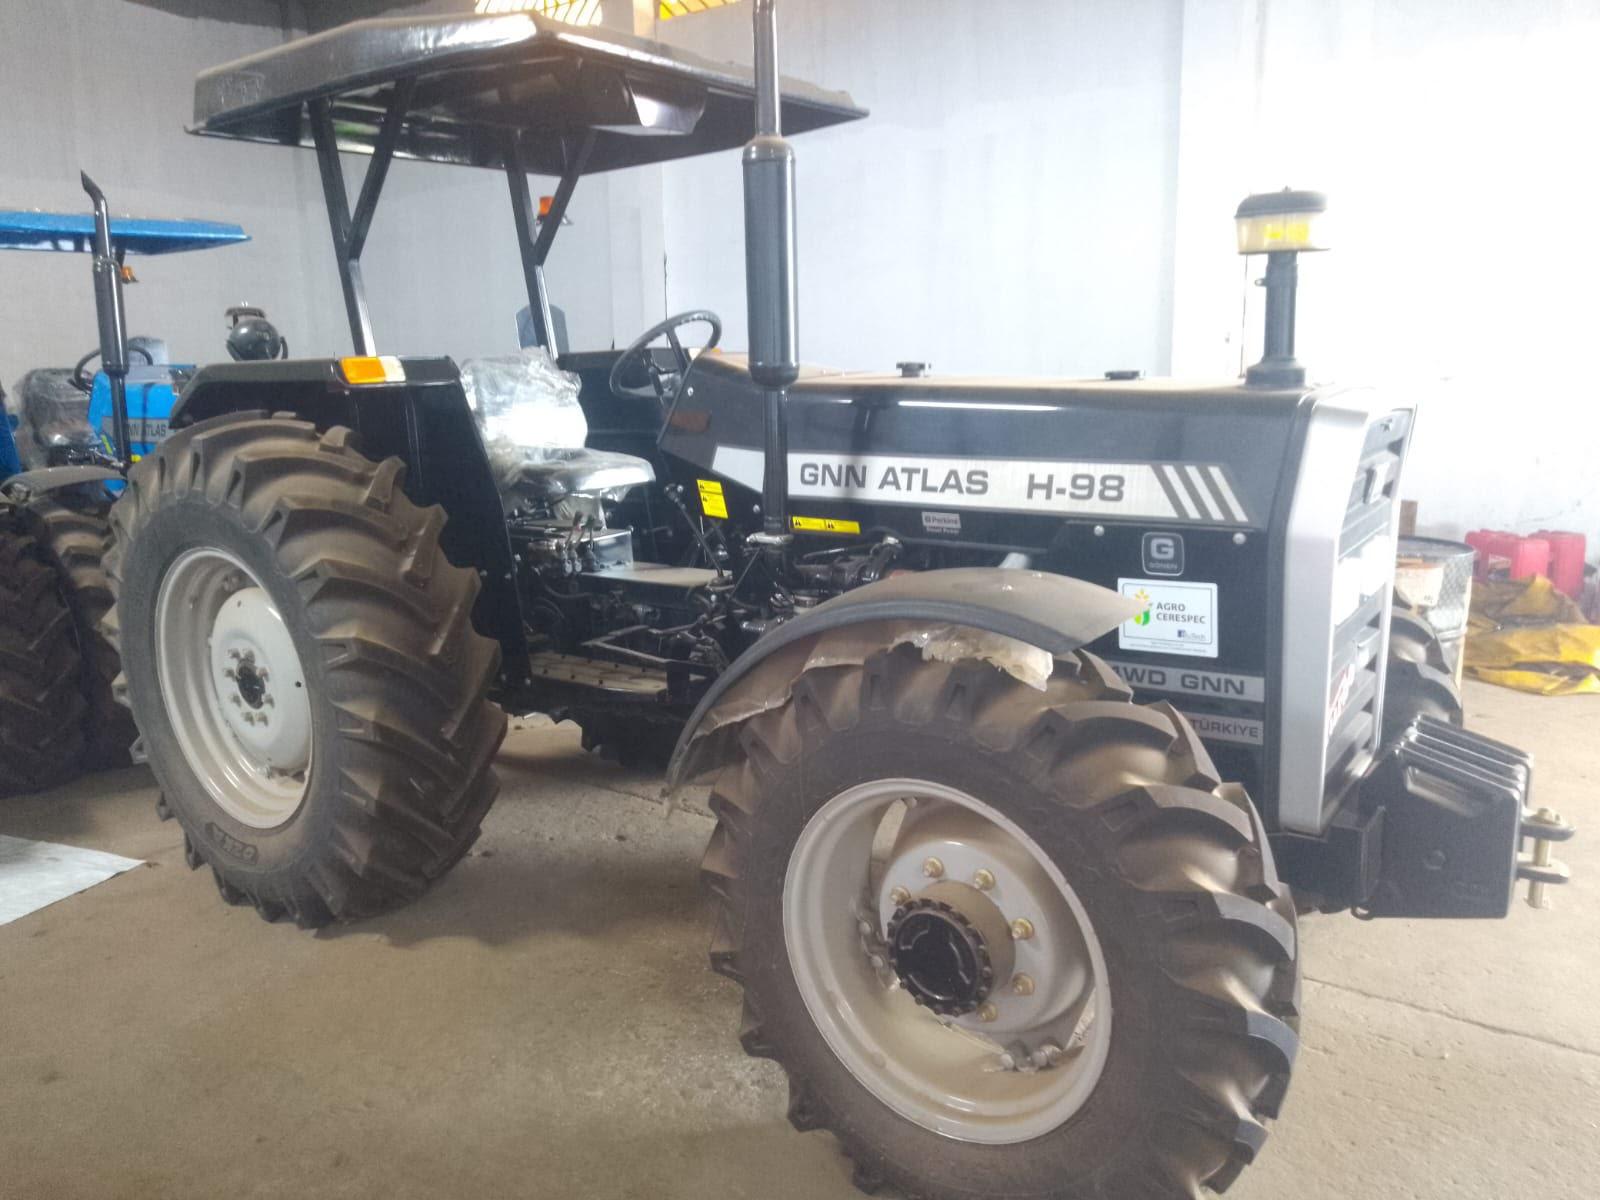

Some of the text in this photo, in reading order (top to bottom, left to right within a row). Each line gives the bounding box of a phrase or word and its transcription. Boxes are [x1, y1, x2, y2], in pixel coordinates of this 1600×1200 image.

[141, 423, 167, 437] TLAS
[800, 463, 1126, 502] GNN ATLAS H-98
[1150, 538, 1175, 560] G
[1156, 601, 1187, 612] AGRO
[1156, 612, 1207, 625] CERESPEC
[1180, 673, 1246, 696] GNN
